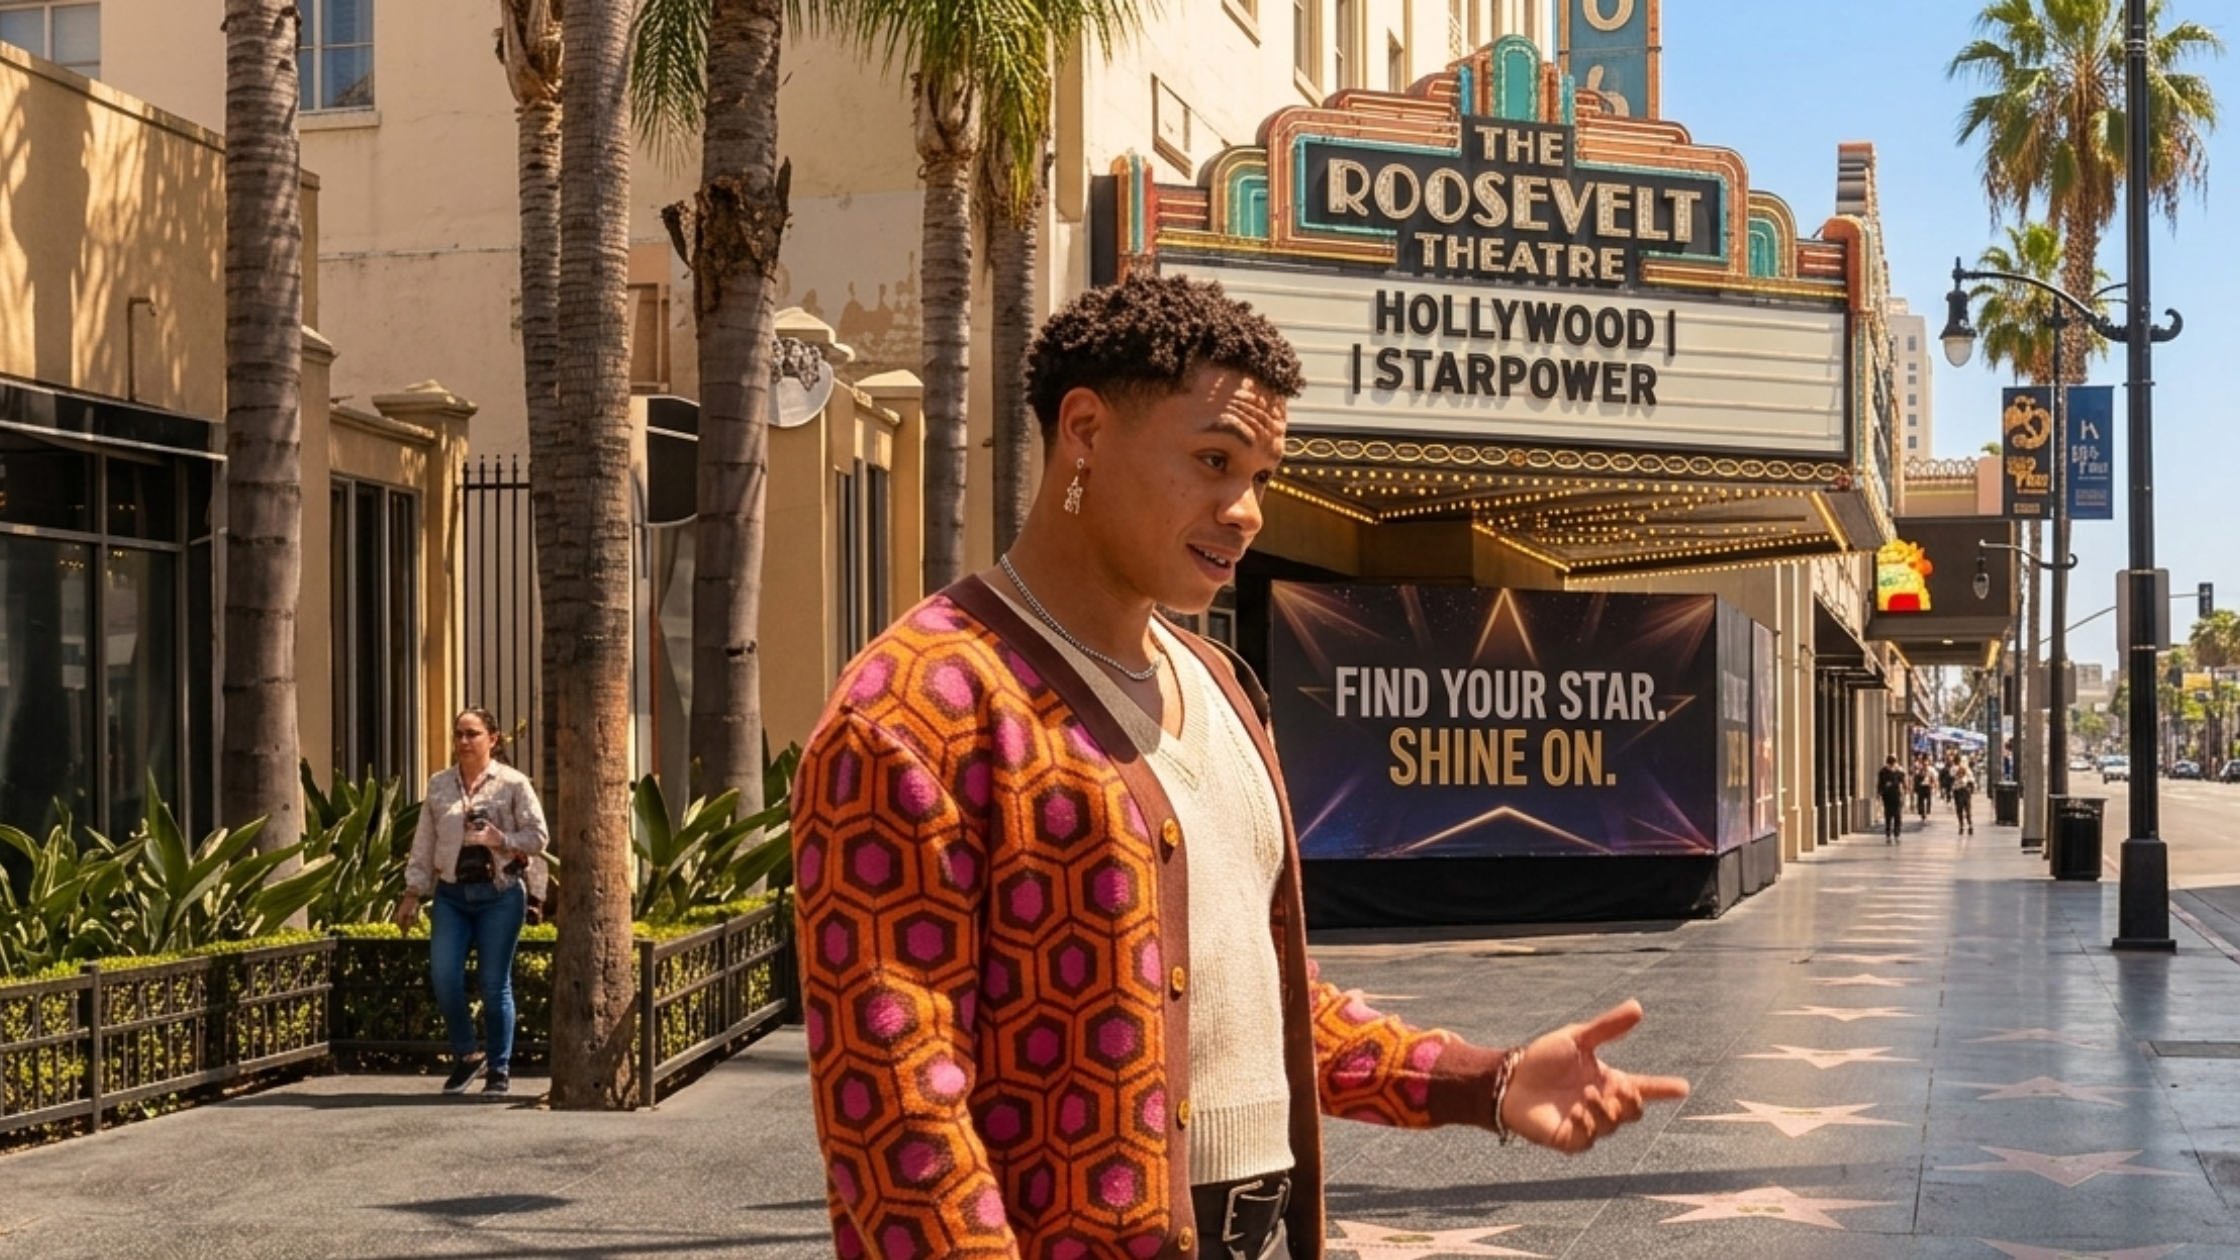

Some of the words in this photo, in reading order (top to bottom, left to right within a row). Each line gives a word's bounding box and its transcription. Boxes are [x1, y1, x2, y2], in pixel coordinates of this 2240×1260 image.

[1475, 125, 1564, 167] THE
[1328, 158, 1702, 243] ROOSEVELT
[1414, 232, 1625, 281] THEATRE
[1376, 290, 1655, 349] HOLLYWOOD
[1376, 347, 1657, 406] STARPOWER
[1336, 666, 1429, 718] FIND
[1440, 668, 1547, 720] YOUR
[1559, 670, 1667, 722] STAR.
[1389, 727, 1527, 786] SHINE
[1542, 729, 1616, 787] ON.
